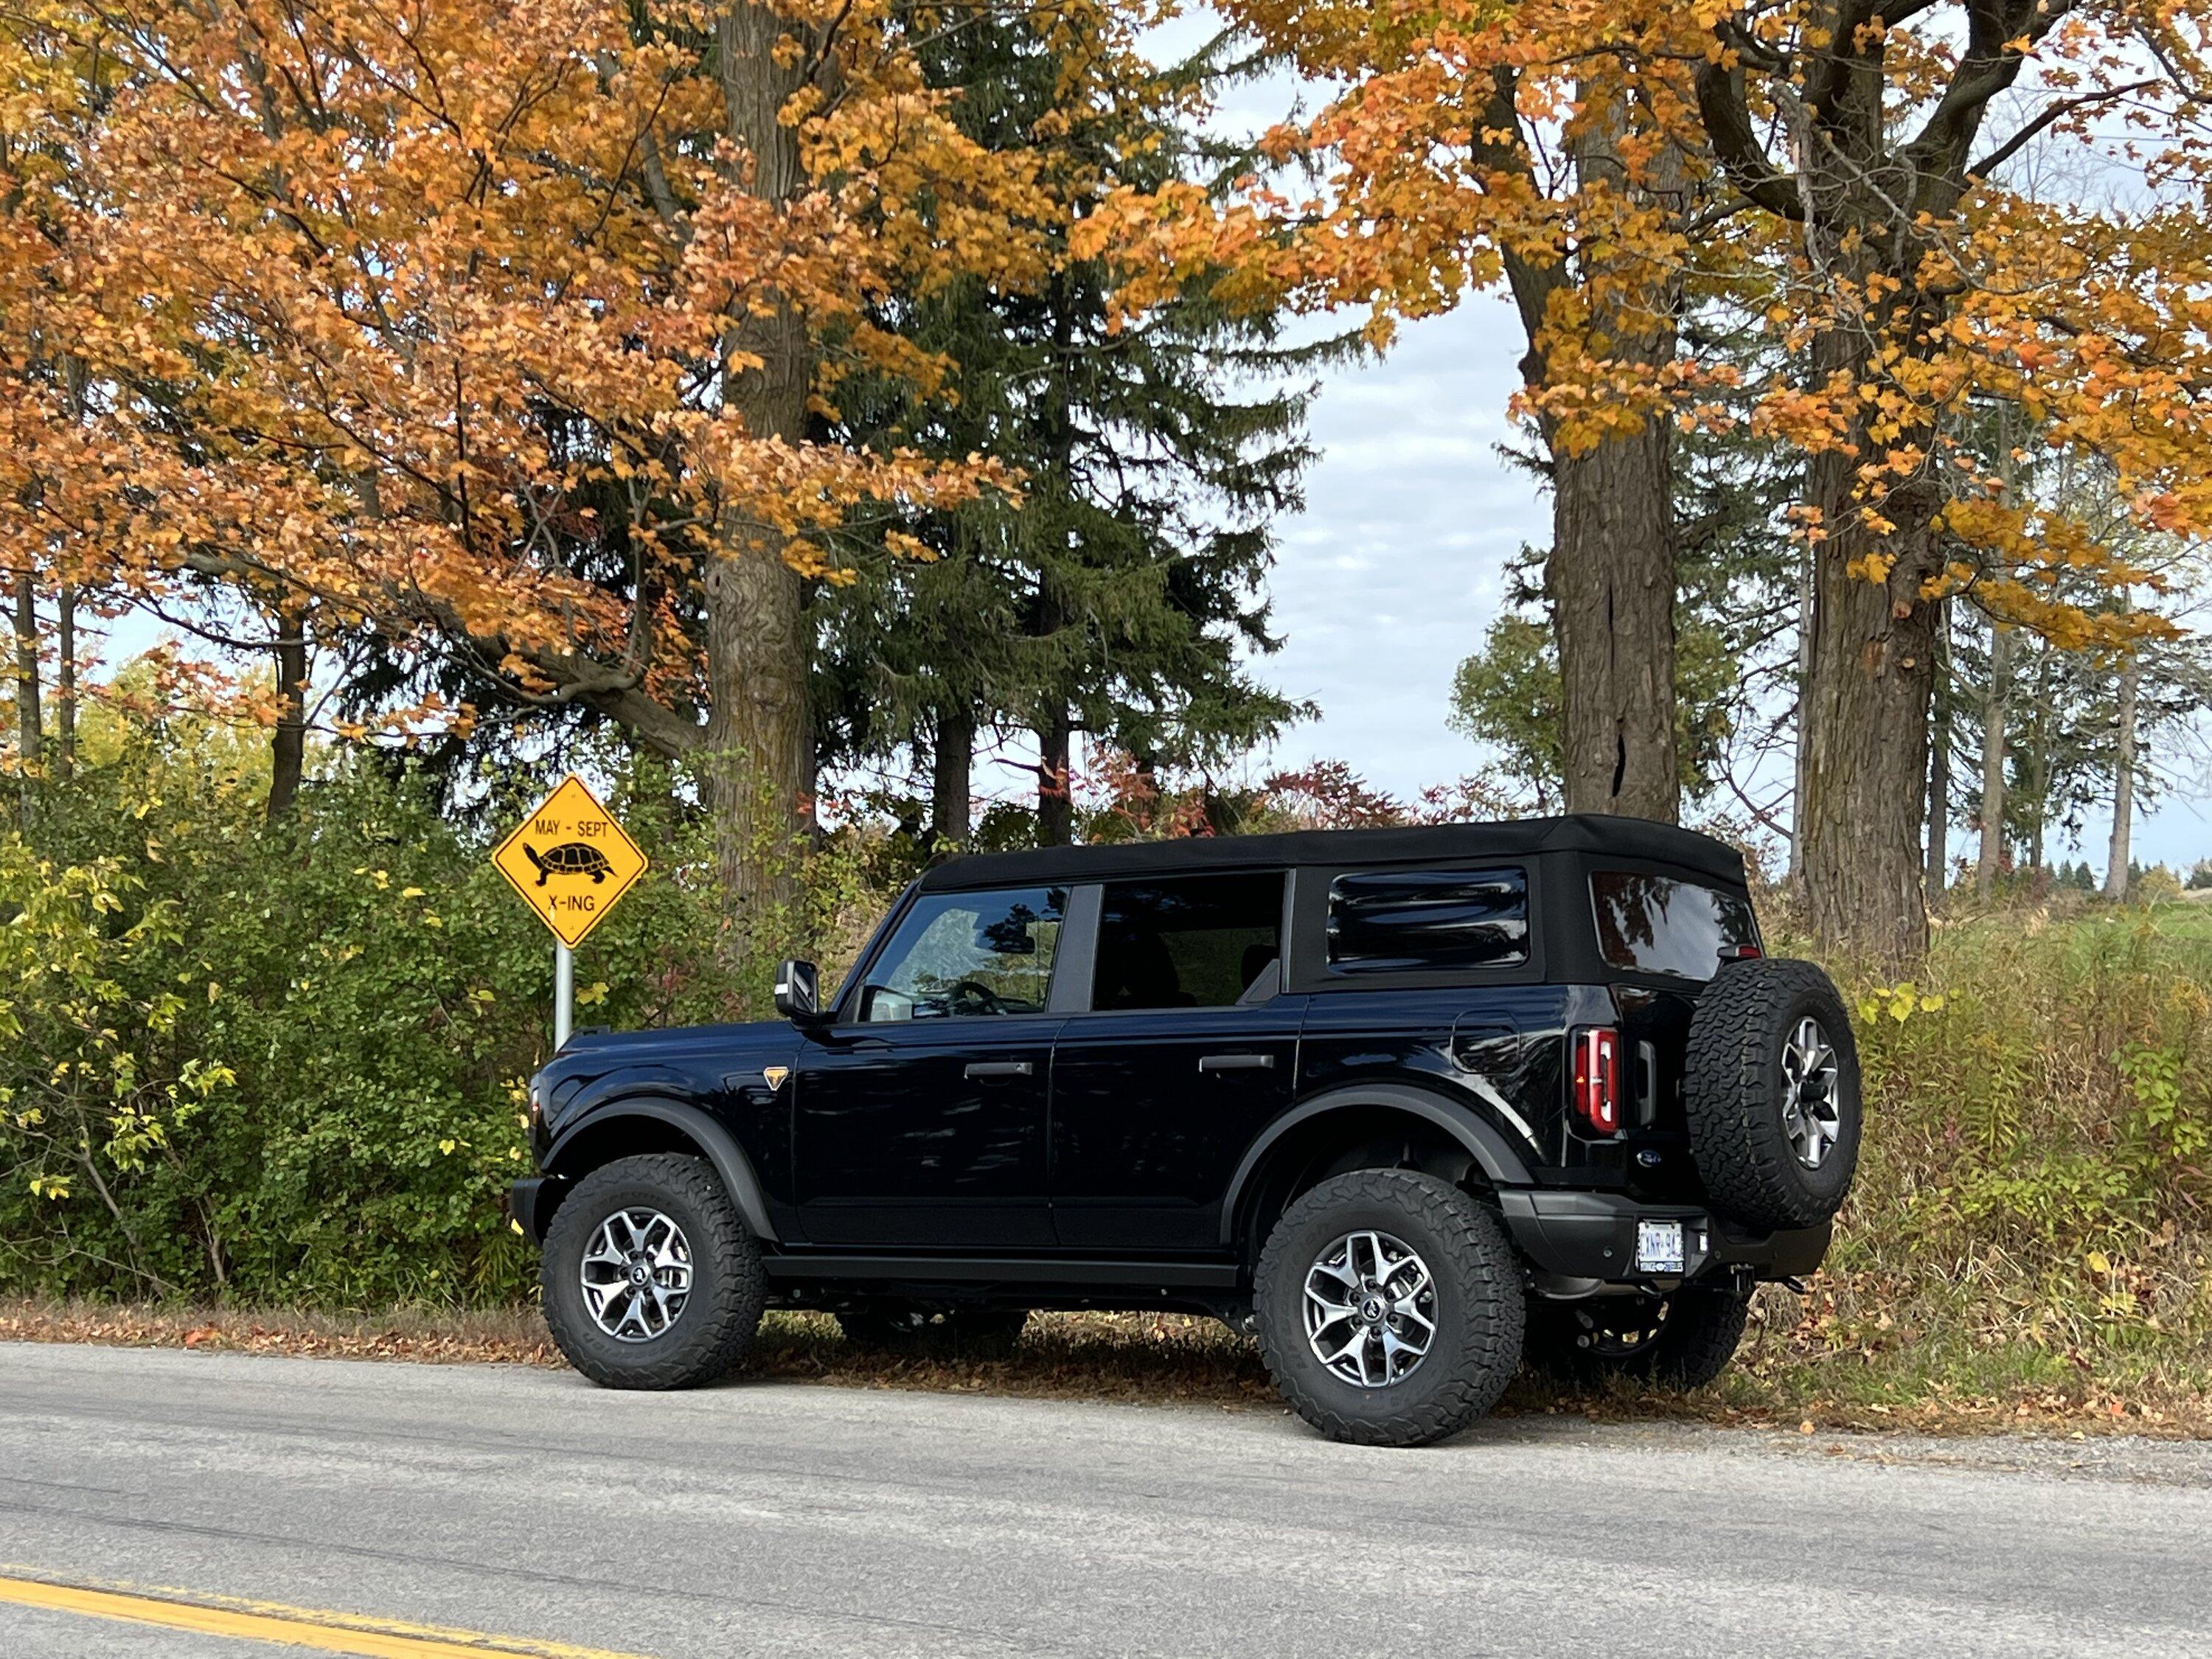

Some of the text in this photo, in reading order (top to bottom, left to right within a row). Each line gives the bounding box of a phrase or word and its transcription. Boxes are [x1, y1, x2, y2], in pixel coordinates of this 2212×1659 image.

[535, 819, 560, 835] MAY
[577, 821, 608, 838] SEPT
[549, 894, 595, 911] X-ING
